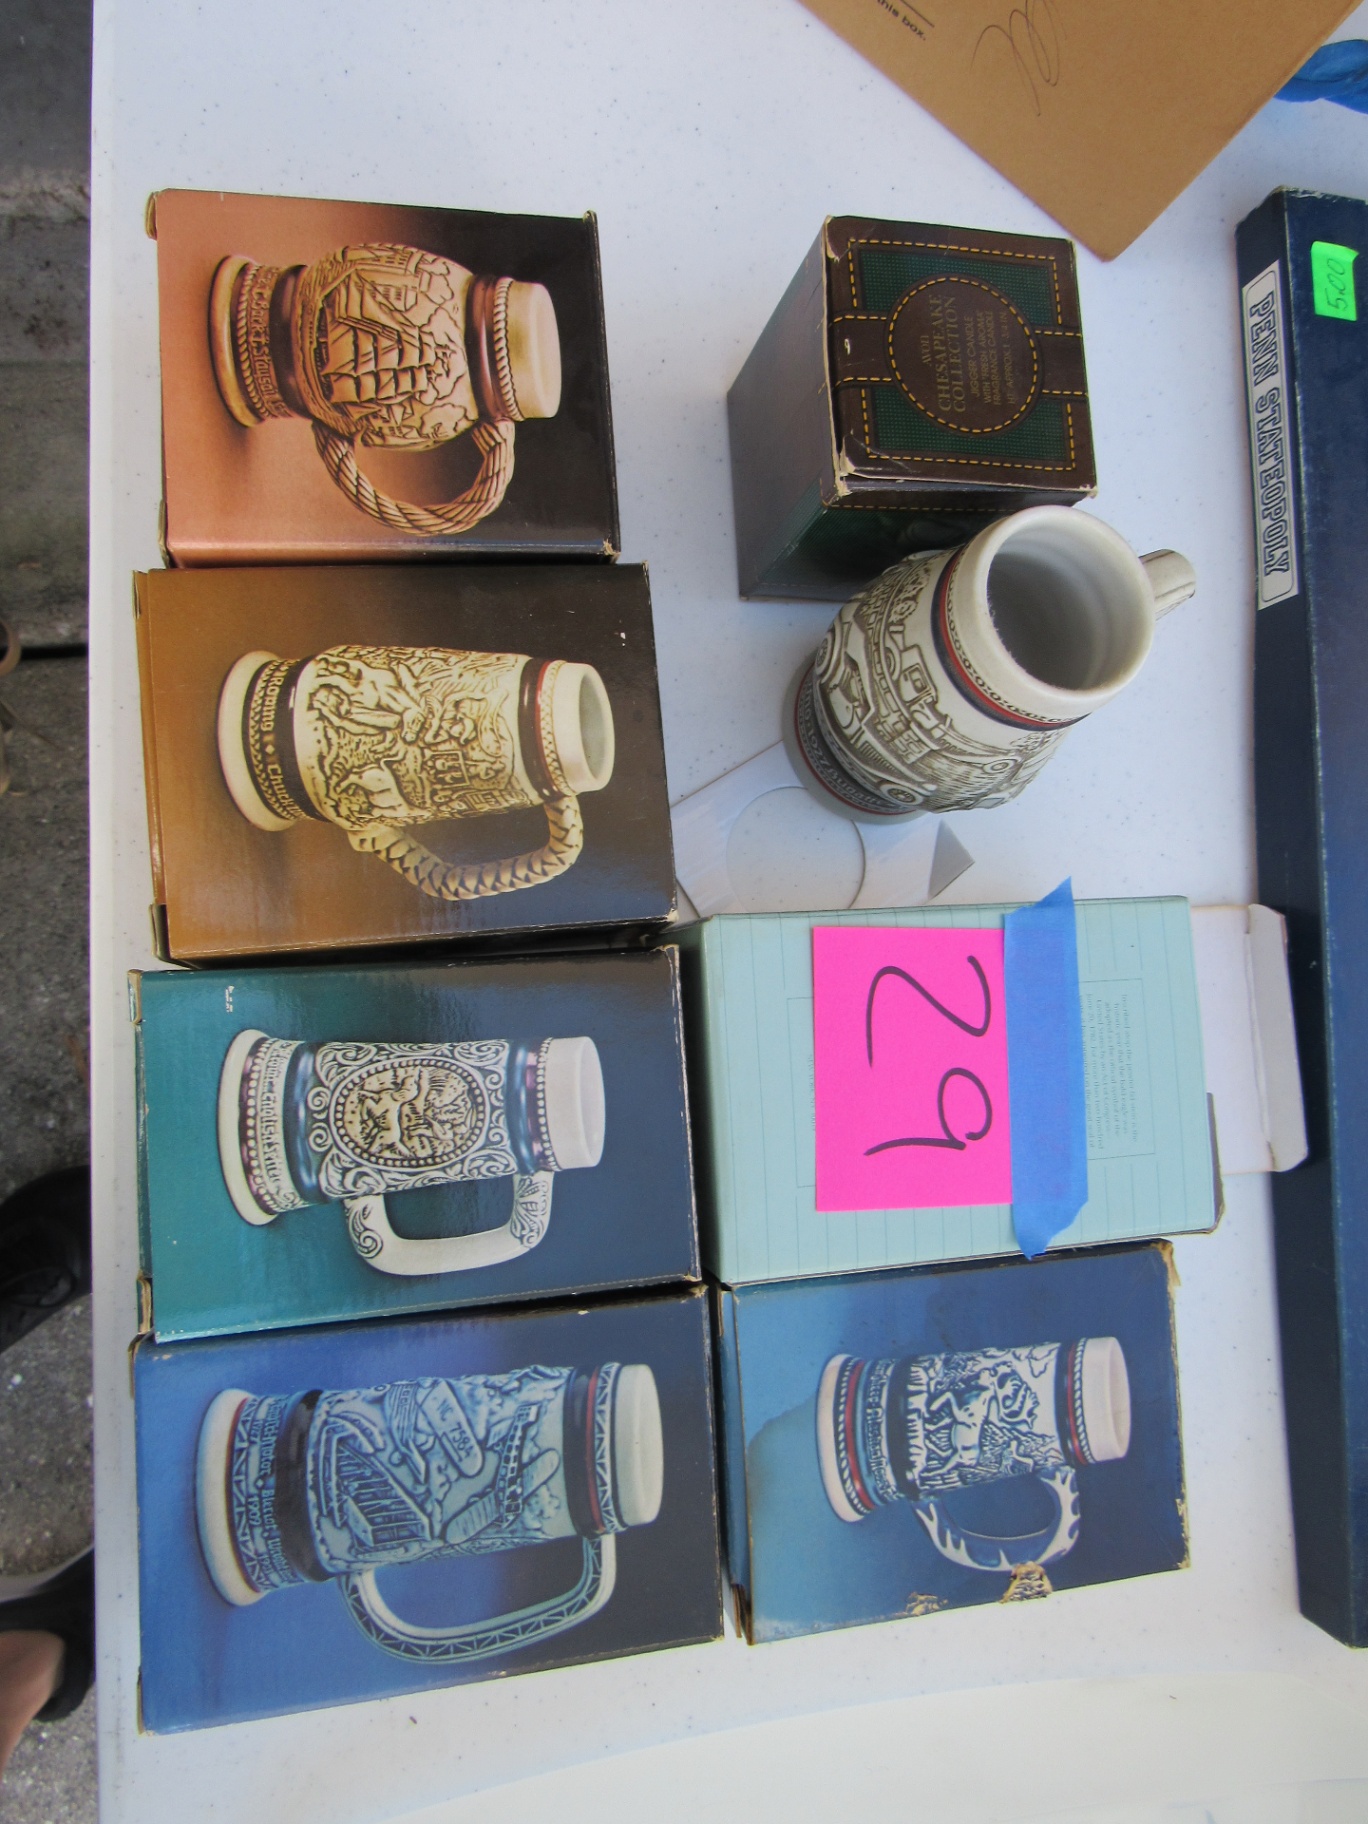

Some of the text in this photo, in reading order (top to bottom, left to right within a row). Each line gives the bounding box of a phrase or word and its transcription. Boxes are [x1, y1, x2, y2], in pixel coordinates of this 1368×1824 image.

[902, 16, 926, 41] box.
[1325, 258, 1348, 311] 5.00
[929, 294, 951, 412] CHESAPEAKE
[944, 296, 966, 413] COLLECTION
[964, 315, 980, 397] JIGGER CANDLE
[982, 381, 992, 403] WITH
[986, 310, 1001, 406] FRAGRANCE CANDLE
[1250, 290, 1290, 577] PENN STATEOPOLY
[260, 677, 294, 806] Roping Chuck
[863, 955, 992, 1156] 29
[260, 1092, 279, 1142] English
[437, 1399, 475, 1459] NC 7584
[248, 1496, 262, 1525] 1909
